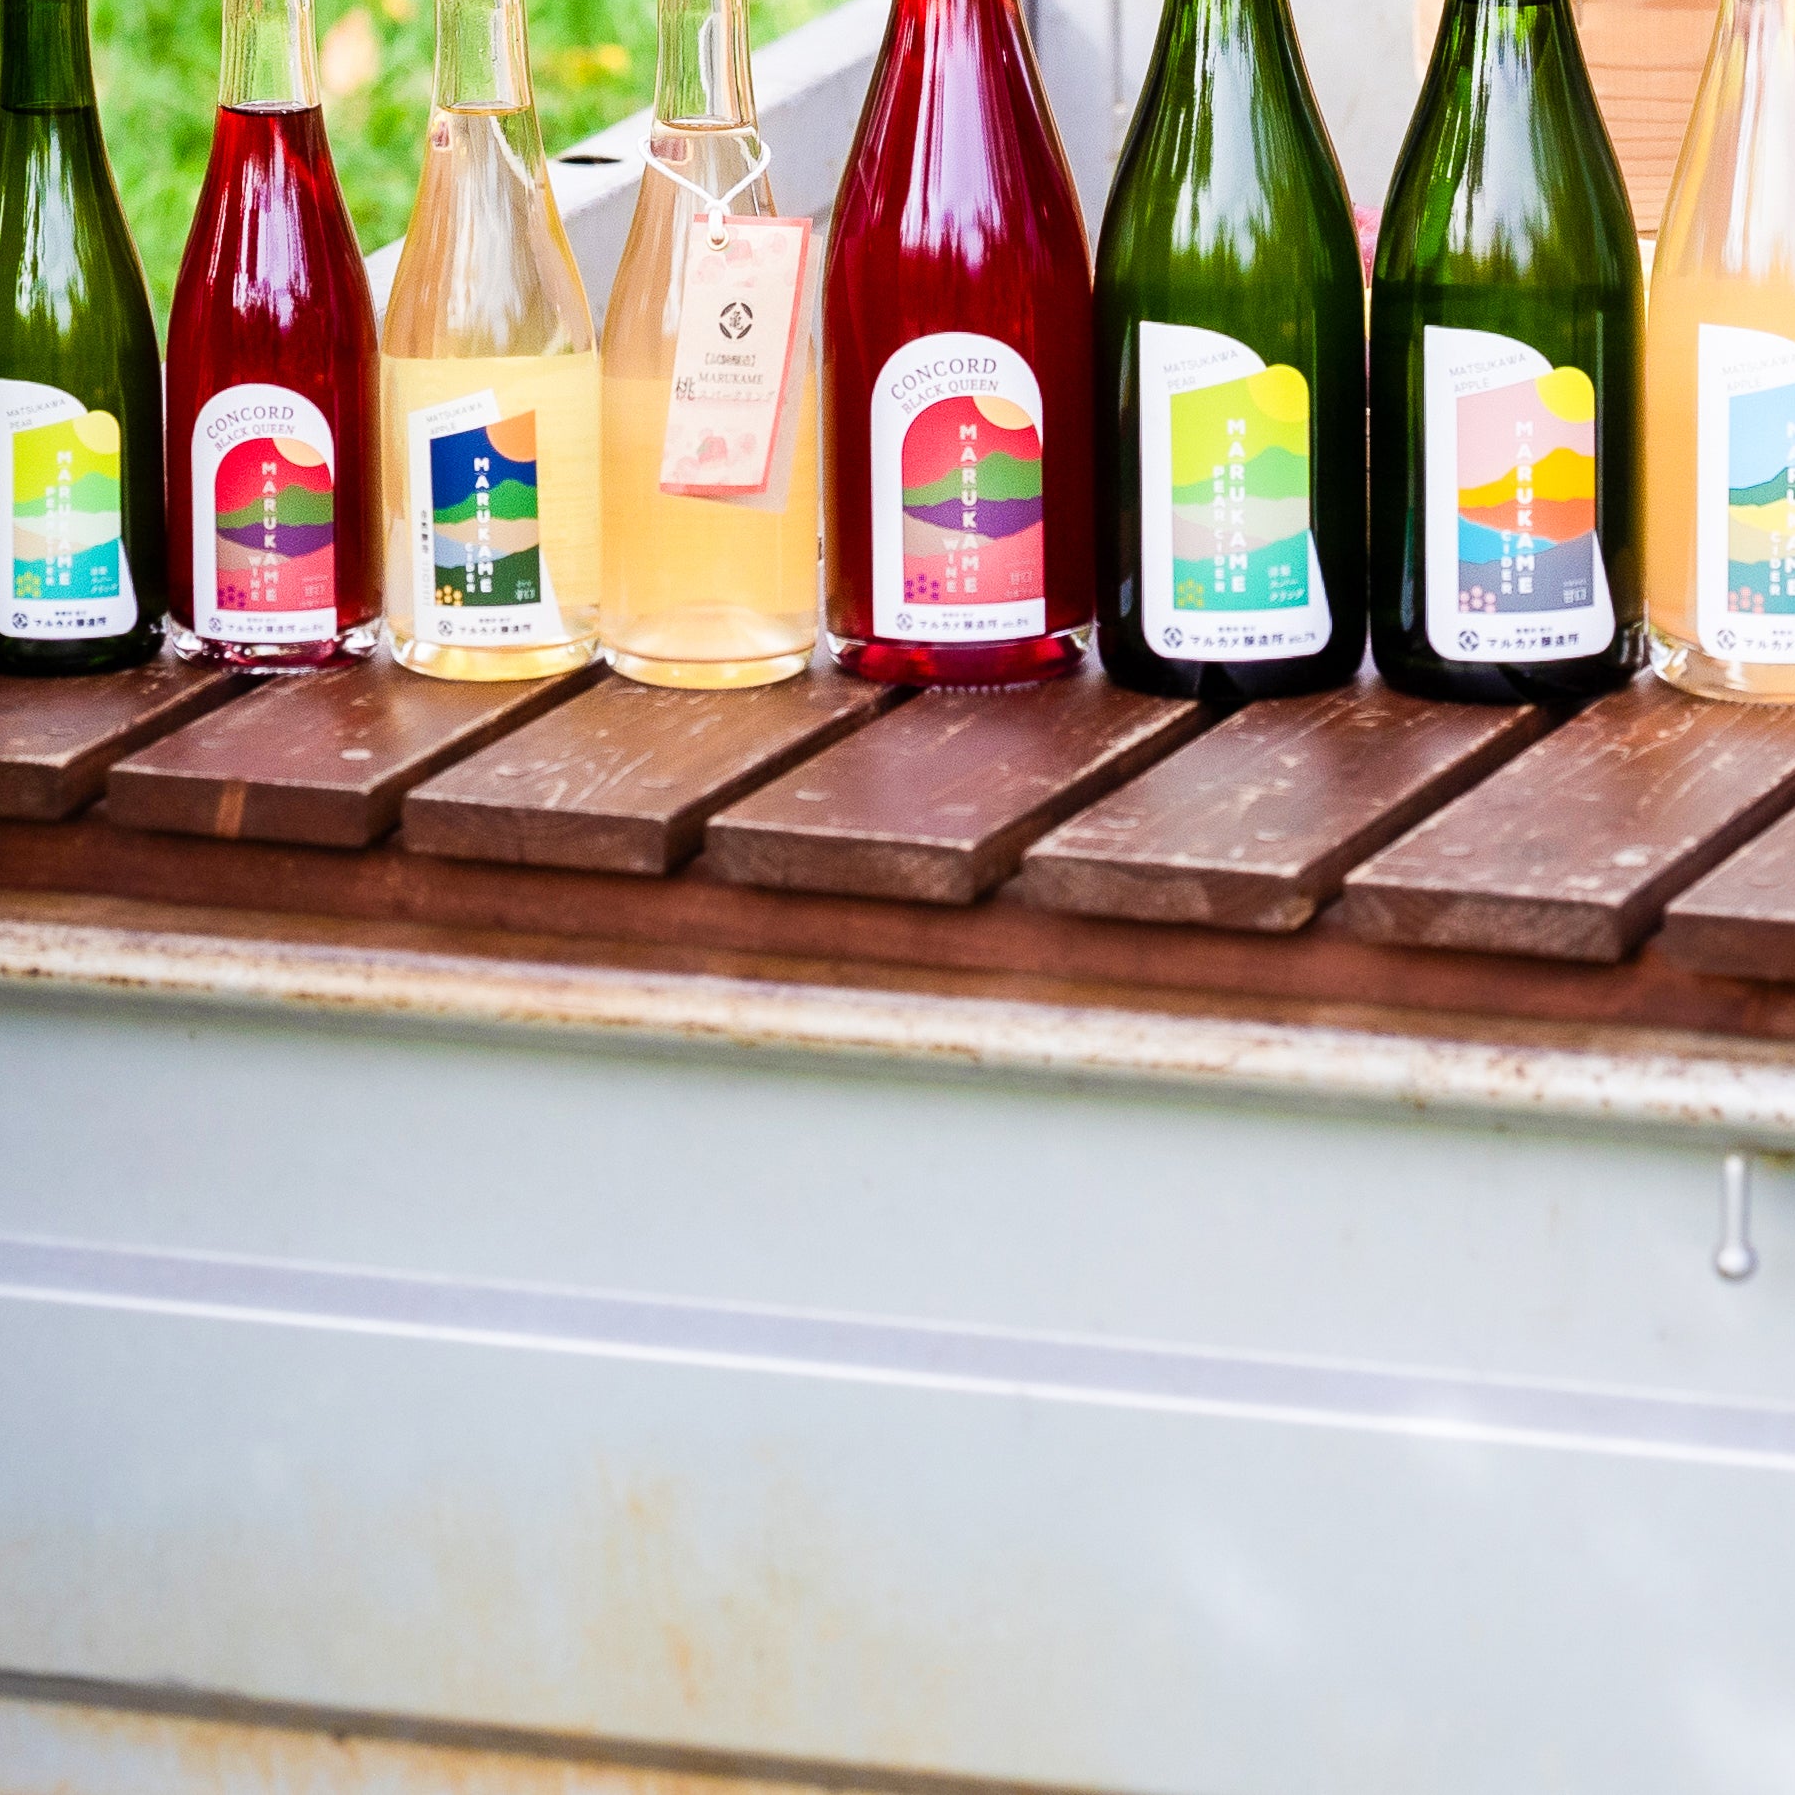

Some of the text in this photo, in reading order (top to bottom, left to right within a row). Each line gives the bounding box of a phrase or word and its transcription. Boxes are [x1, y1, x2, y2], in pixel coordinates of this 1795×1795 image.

[698, 371, 763, 385] MARUKAME
[890, 357, 997, 401] CONCORD
[1162, 349, 1238, 375] MATSUKAWA
[1166, 376, 1197, 391] PEAR
[1448, 353, 1527, 378] MATSUKAWA
[1453, 377, 1491, 394] APPLE
[901, 378, 999, 416] BLACK QUEEN
[206, 405, 295, 440] CONCORD
[213, 423, 295, 452] BLACK QUEEN
[56, 450, 73, 586] MARUKAME
[959, 423, 980, 594] MARUKAME
[1212, 465, 1226, 524] PEAR
[1226, 418, 1248, 593] MARUKAME
[1514, 420, 1535, 595] MARUKAME
[261, 461, 279, 603] MARUKAME
[473, 456, 494, 594] MARUKAME
[942, 537, 958, 593] WINE
[1769, 531, 1781, 597] CIDER
